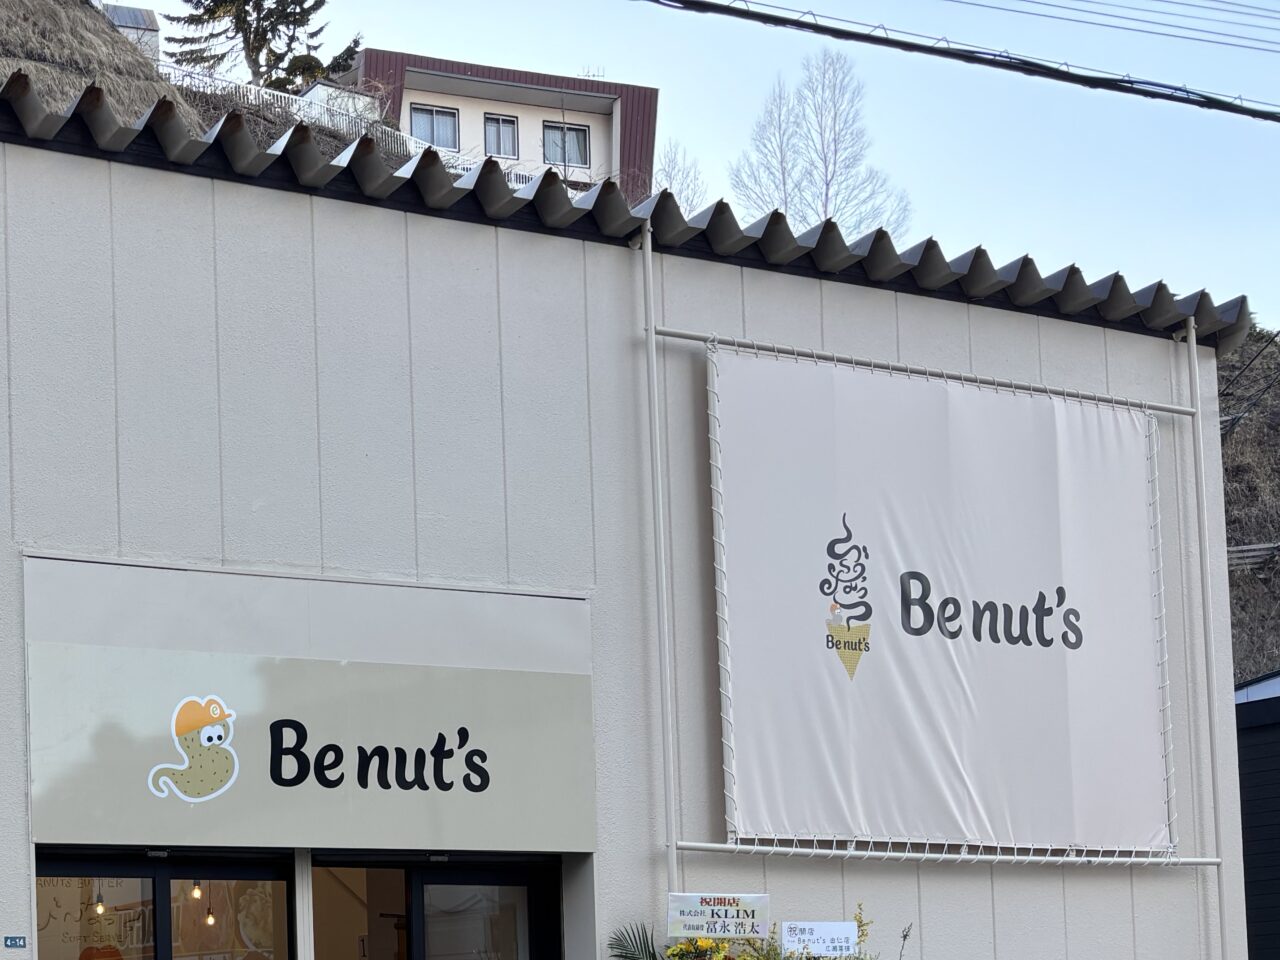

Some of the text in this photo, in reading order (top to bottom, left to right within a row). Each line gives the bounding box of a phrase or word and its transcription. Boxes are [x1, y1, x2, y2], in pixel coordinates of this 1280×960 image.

[699, 896, 741, 907] 祝開店
[710, 908, 756, 919] KLIM
